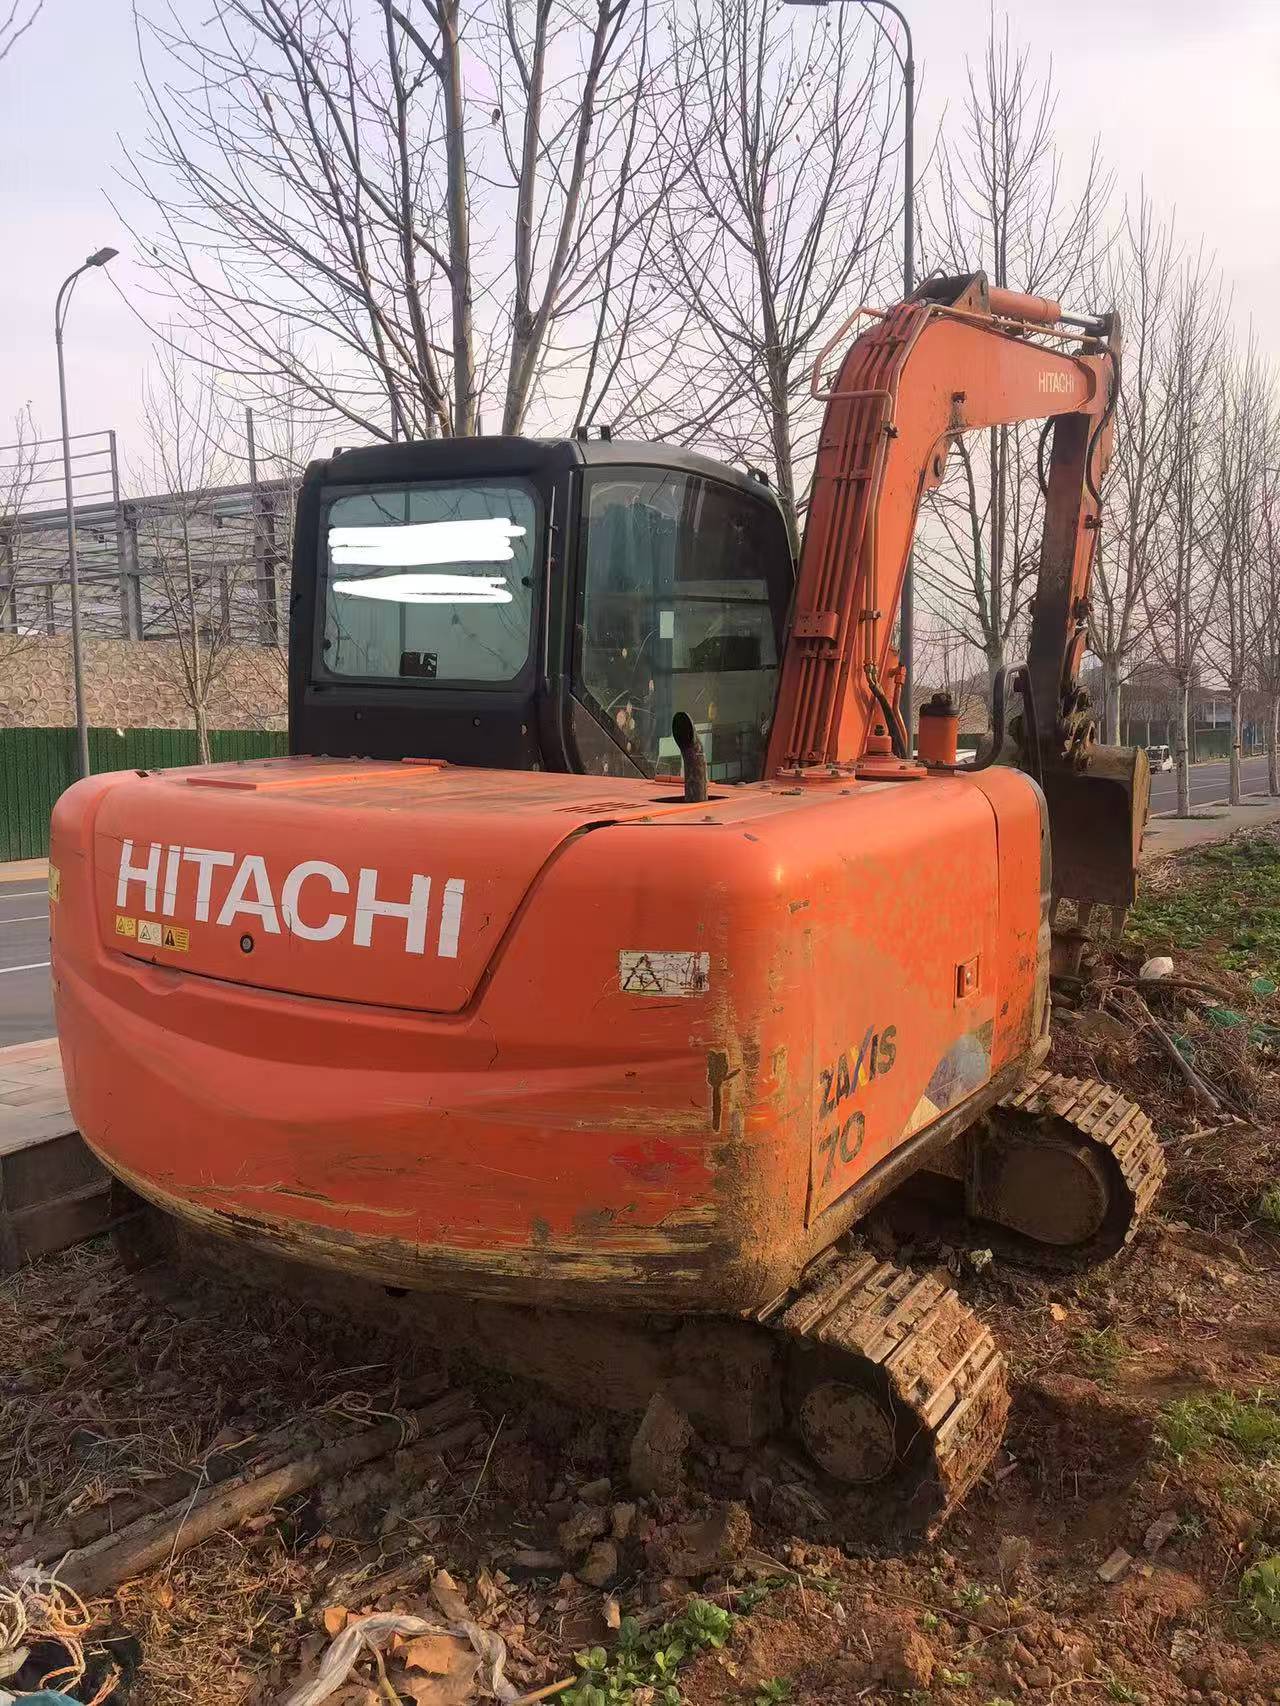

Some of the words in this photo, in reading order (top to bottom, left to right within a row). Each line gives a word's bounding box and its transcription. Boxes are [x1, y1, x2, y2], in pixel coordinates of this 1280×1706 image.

[1038, 371, 1075, 393] HITACHI
[115, 839, 466, 958] HITACHI
[818, 1023, 897, 1120] ZAXIS
[818, 1110, 866, 1188] 70
